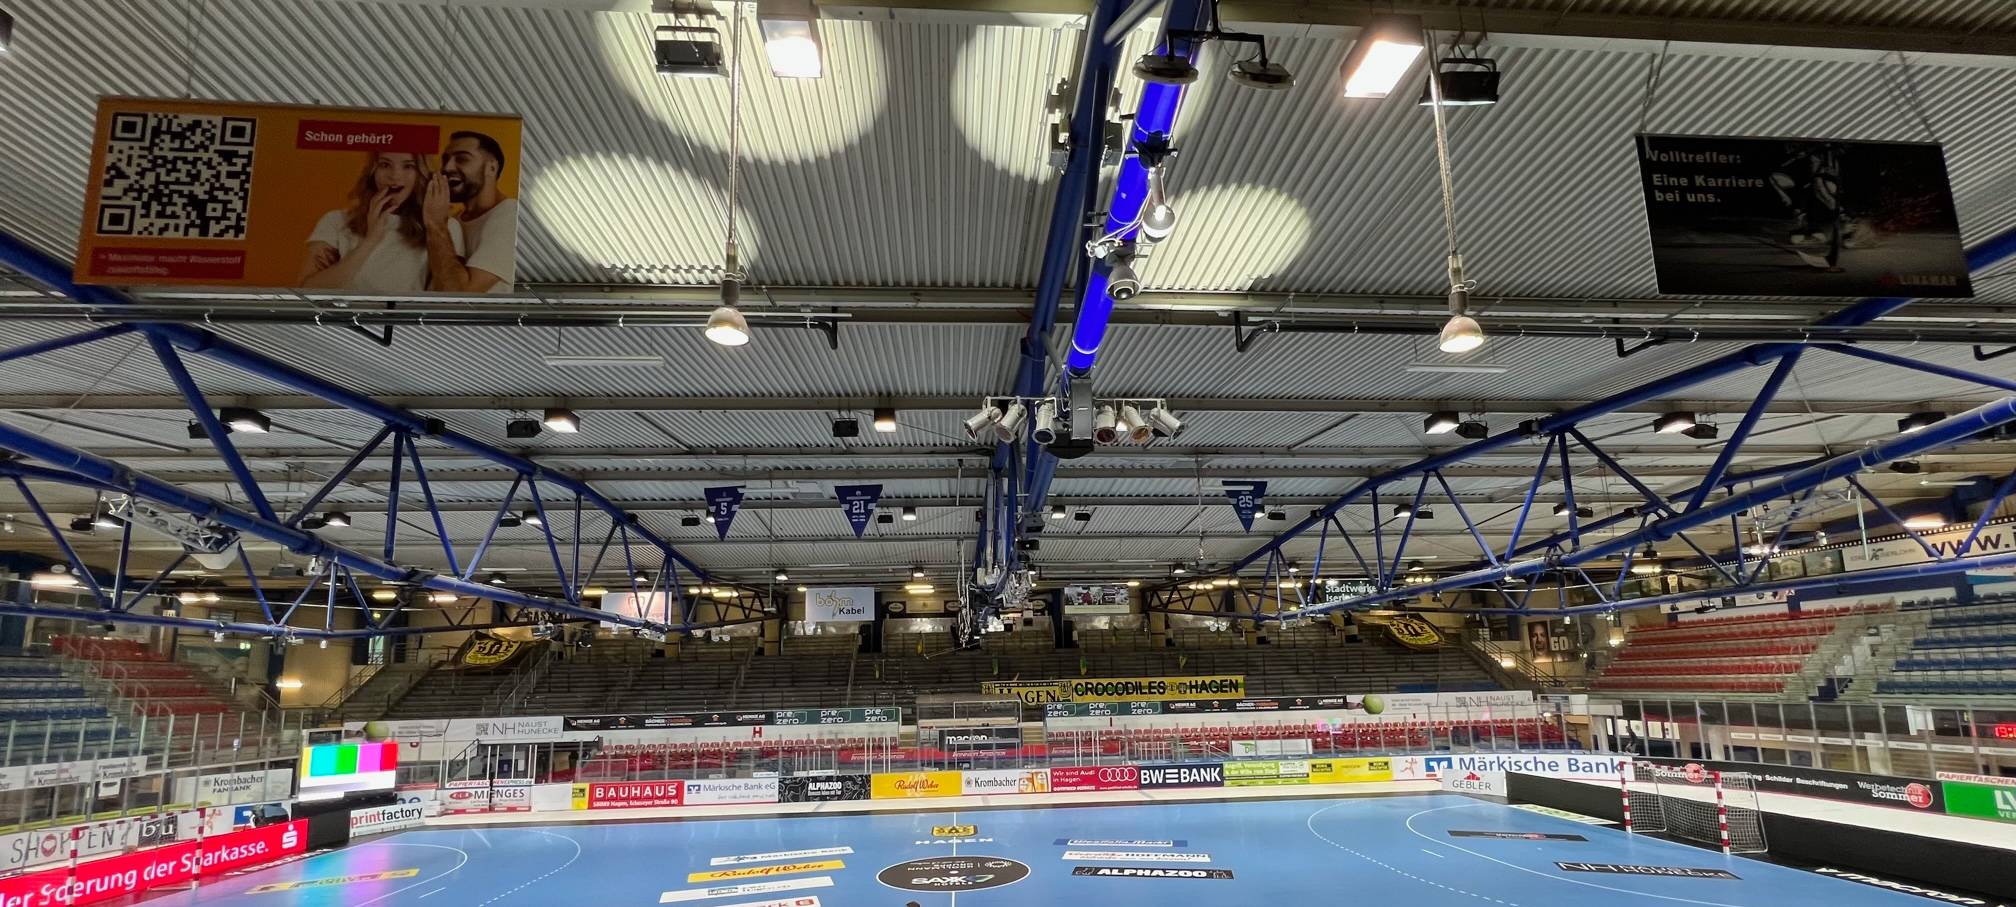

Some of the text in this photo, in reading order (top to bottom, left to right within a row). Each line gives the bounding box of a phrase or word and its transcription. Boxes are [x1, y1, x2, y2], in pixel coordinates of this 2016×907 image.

[304, 130, 394, 146] Schon gehört?
[1648, 150, 1741, 164] Volltreffer:
[1652, 174, 1764, 188] Eine Karriere
[1654, 189, 1721, 203] bei uns.
[852, 500, 865, 513] 21
[1238, 495, 1253, 508] 25
[720, 502, 728, 515] 5
[1325, 582, 1377, 593] Stadtwerke
[839, 606, 865, 615] Kabel
[1074, 679, 1239, 696] CROCODILES HAGEN
[1046, 703, 1062, 711] pre
[1089, 702, 1105, 710] pre
[1130, 701, 1146, 709] pre
[776, 711, 793, 719] pre
[820, 709, 838, 718] pre
[864, 708, 881, 716] pre
[492, 723, 515, 735] NH
[517, 721, 549, 729] NAUST
[1459, 756, 1623, 774] Märkische Bank
[894, 779, 939, 791] Rudolf Weber
[974, 776, 1017, 788] Krombacher
[1452, 779, 1492, 791] GEBLER
[1764, 774, 1793, 784] Schilder
[595, 784, 678, 798] BAUHAUS
[703, 783, 776, 792] Märkische Bank eG
[808, 781, 842, 790] ALPHAZOO
[1871, 789, 1924, 803] Sommer
[351, 805, 423, 829] printfactory
[914, 837, 994, 845] HAGEN
[143, 861, 177, 881] der
[180, 841, 270, 874] Sparkasse.
[1097, 868, 1207, 878] ALPHAZOO
